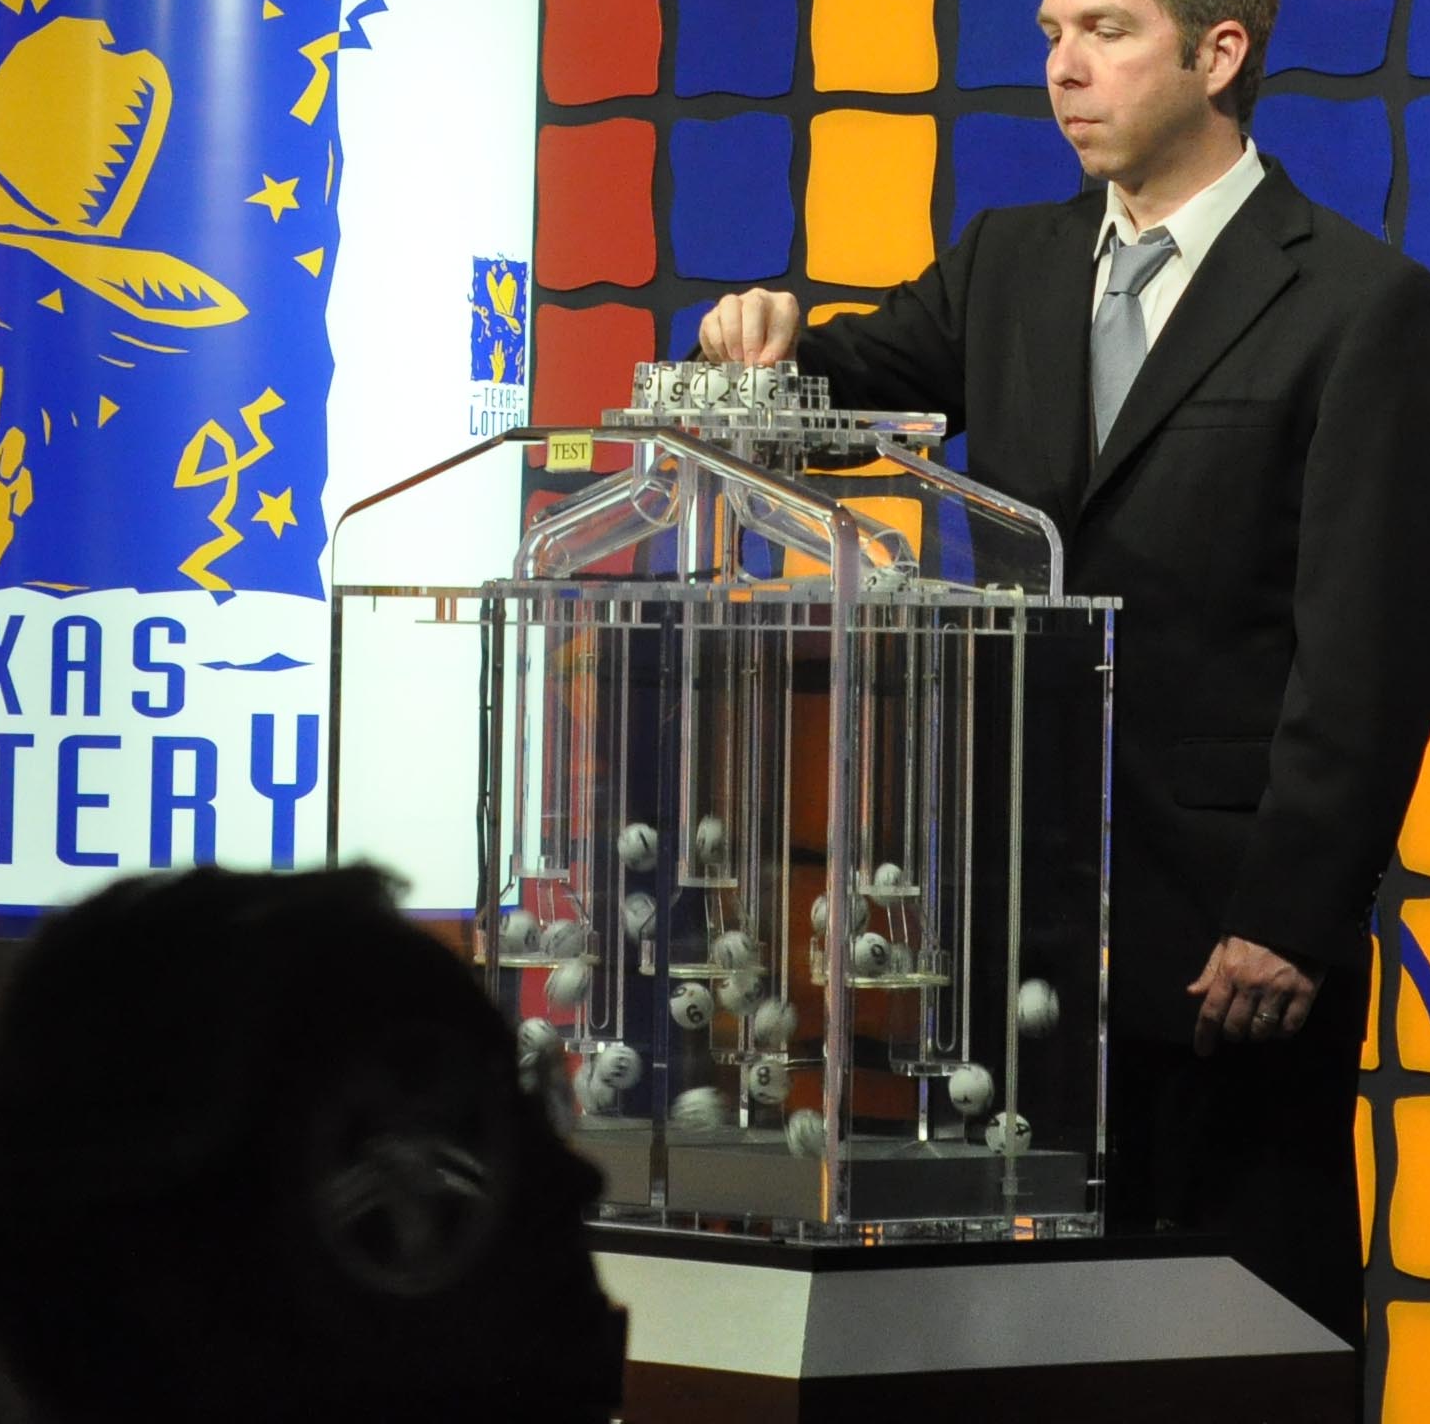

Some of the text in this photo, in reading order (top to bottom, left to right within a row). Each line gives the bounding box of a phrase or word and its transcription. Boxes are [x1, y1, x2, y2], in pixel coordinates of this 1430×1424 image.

[482, 386, 517, 410] TEXAS
[551, 441, 589, 460] TEST
[757, 1065, 770, 1087] 8
